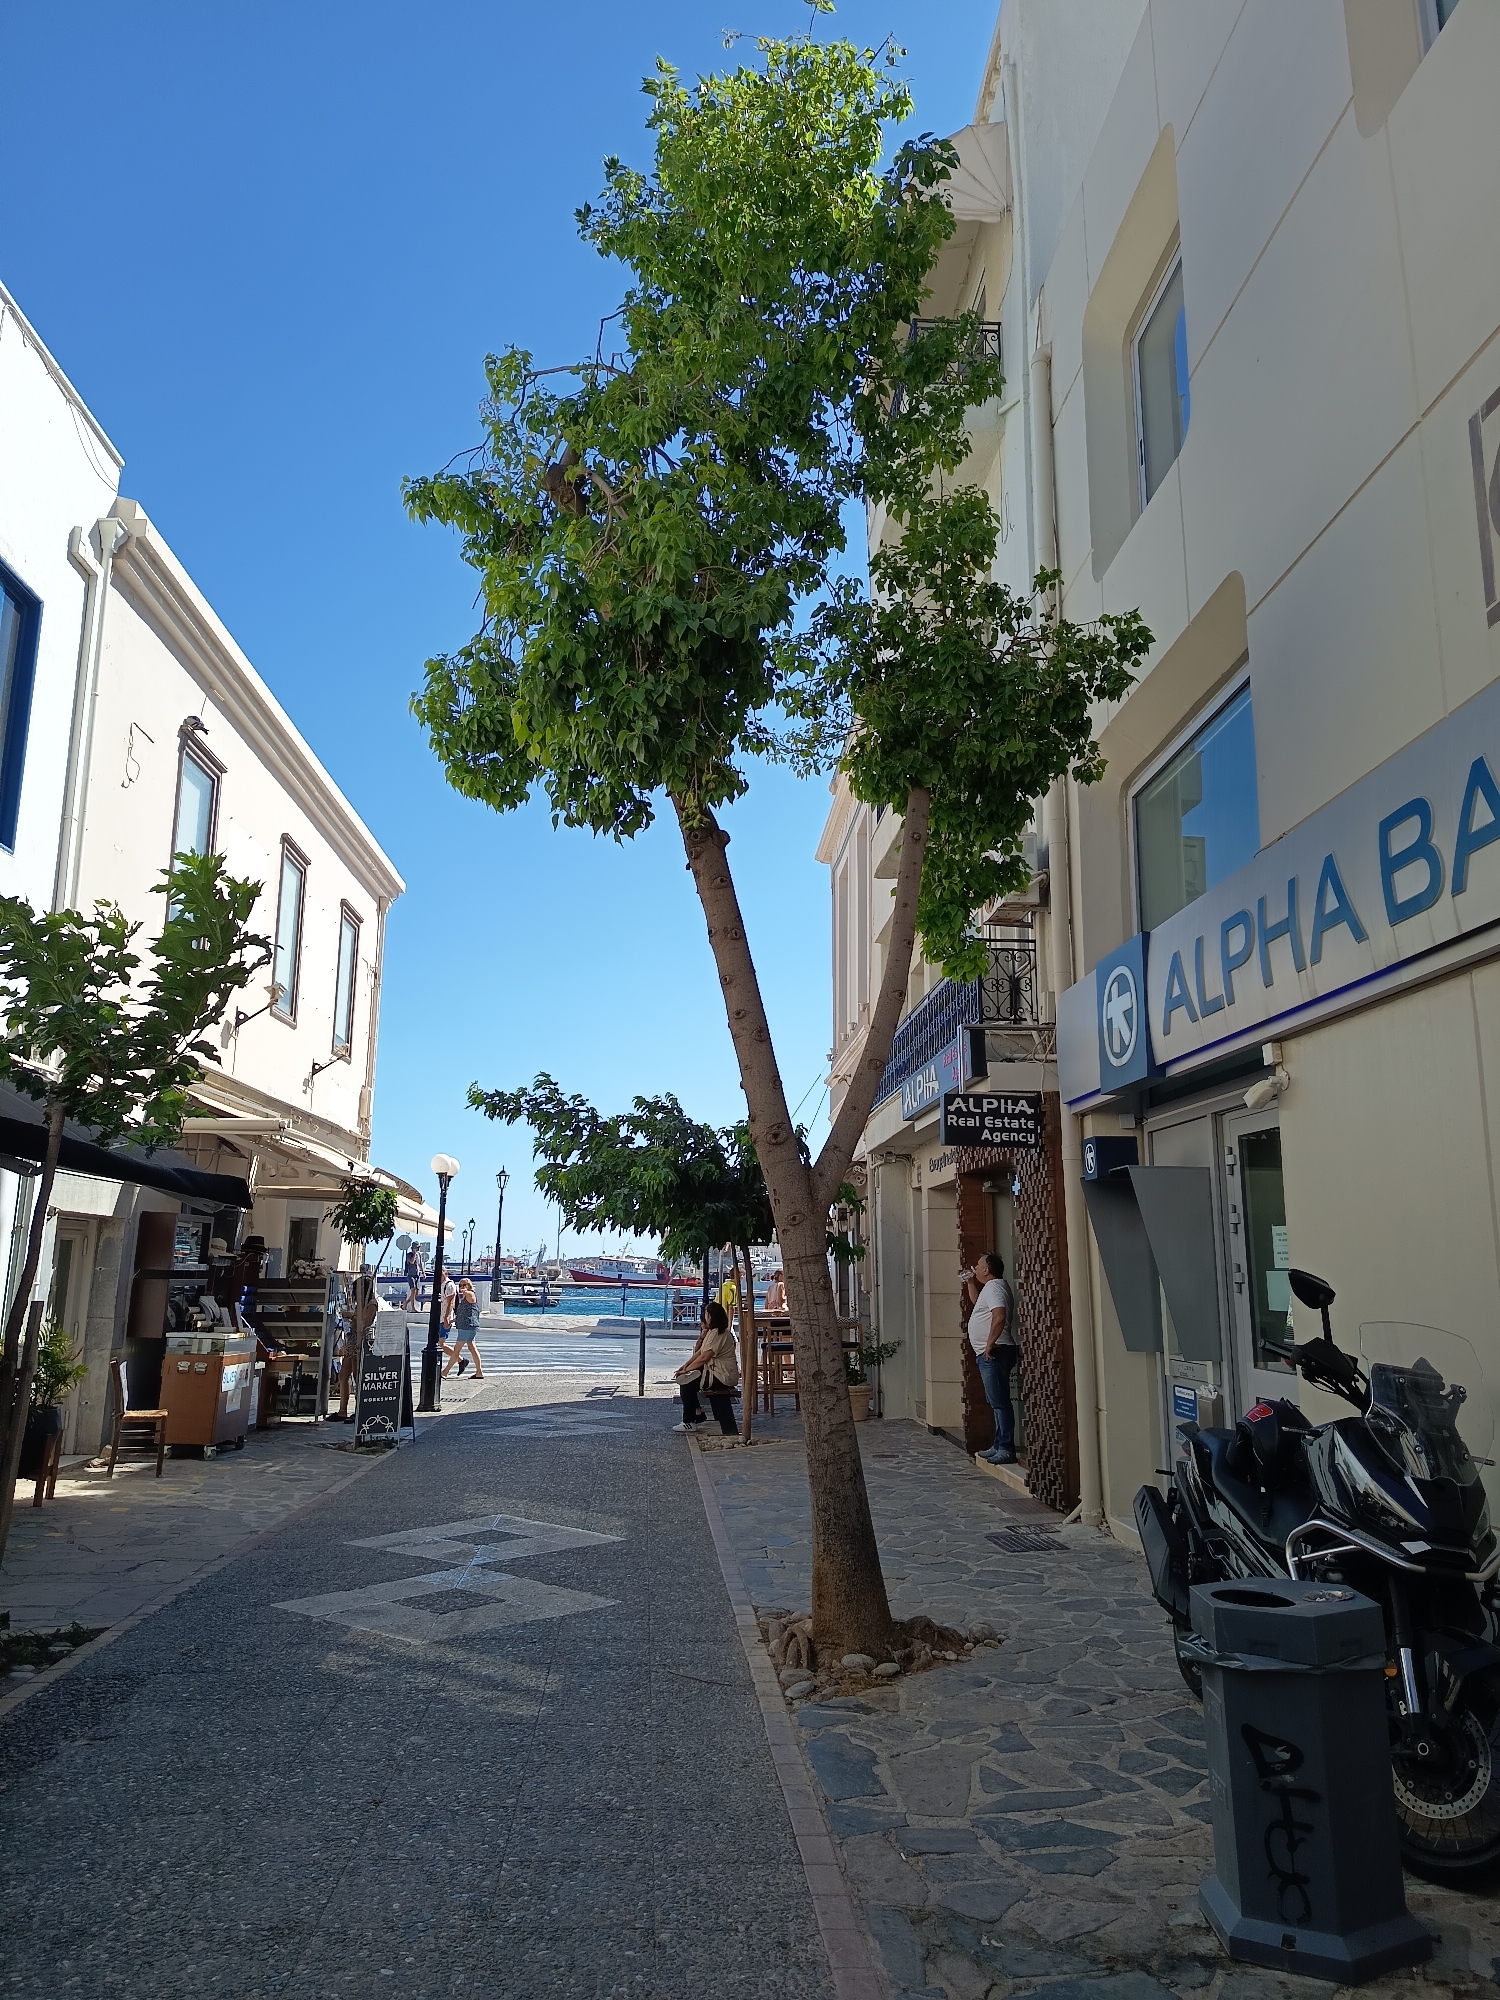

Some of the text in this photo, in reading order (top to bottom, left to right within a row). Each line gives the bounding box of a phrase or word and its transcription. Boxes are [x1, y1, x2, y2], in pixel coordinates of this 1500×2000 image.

[1162, 851, 1369, 1036] ALPHA
[903, 1063, 940, 1115] ALPHA
[947, 1097, 1035, 1115] ALPHA
[947, 1114, 1035, 1129] Real Estate
[980, 1128, 1036, 1144] Agency
[364, 1371, 398, 1381] SILVER
[362, 1381, 400, 1390] MARKET
